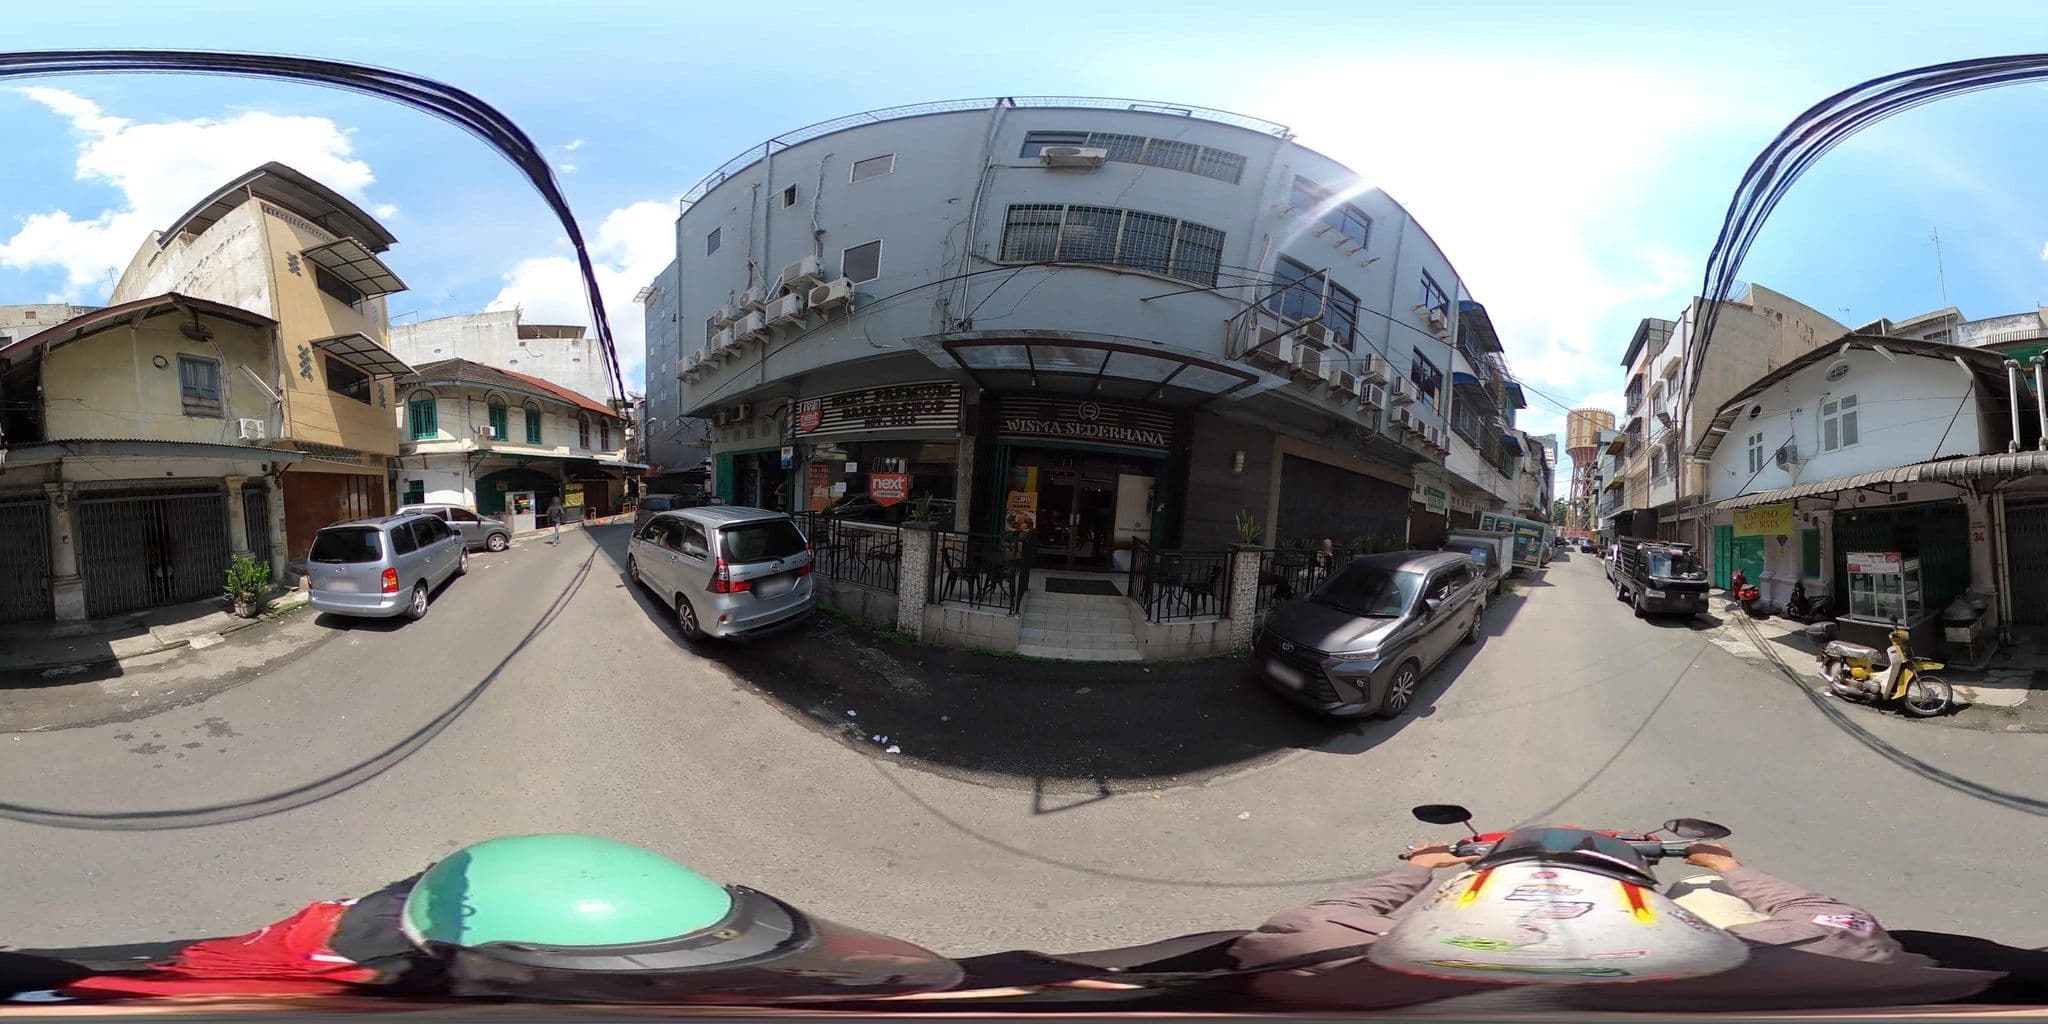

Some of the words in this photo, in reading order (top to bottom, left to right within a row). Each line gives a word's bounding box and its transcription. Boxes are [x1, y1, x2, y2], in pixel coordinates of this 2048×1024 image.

[1006, 418, 1061, 434] WISMA
[1065, 422, 1165, 446] SEDERHANA
[872, 477, 905, 490] next
